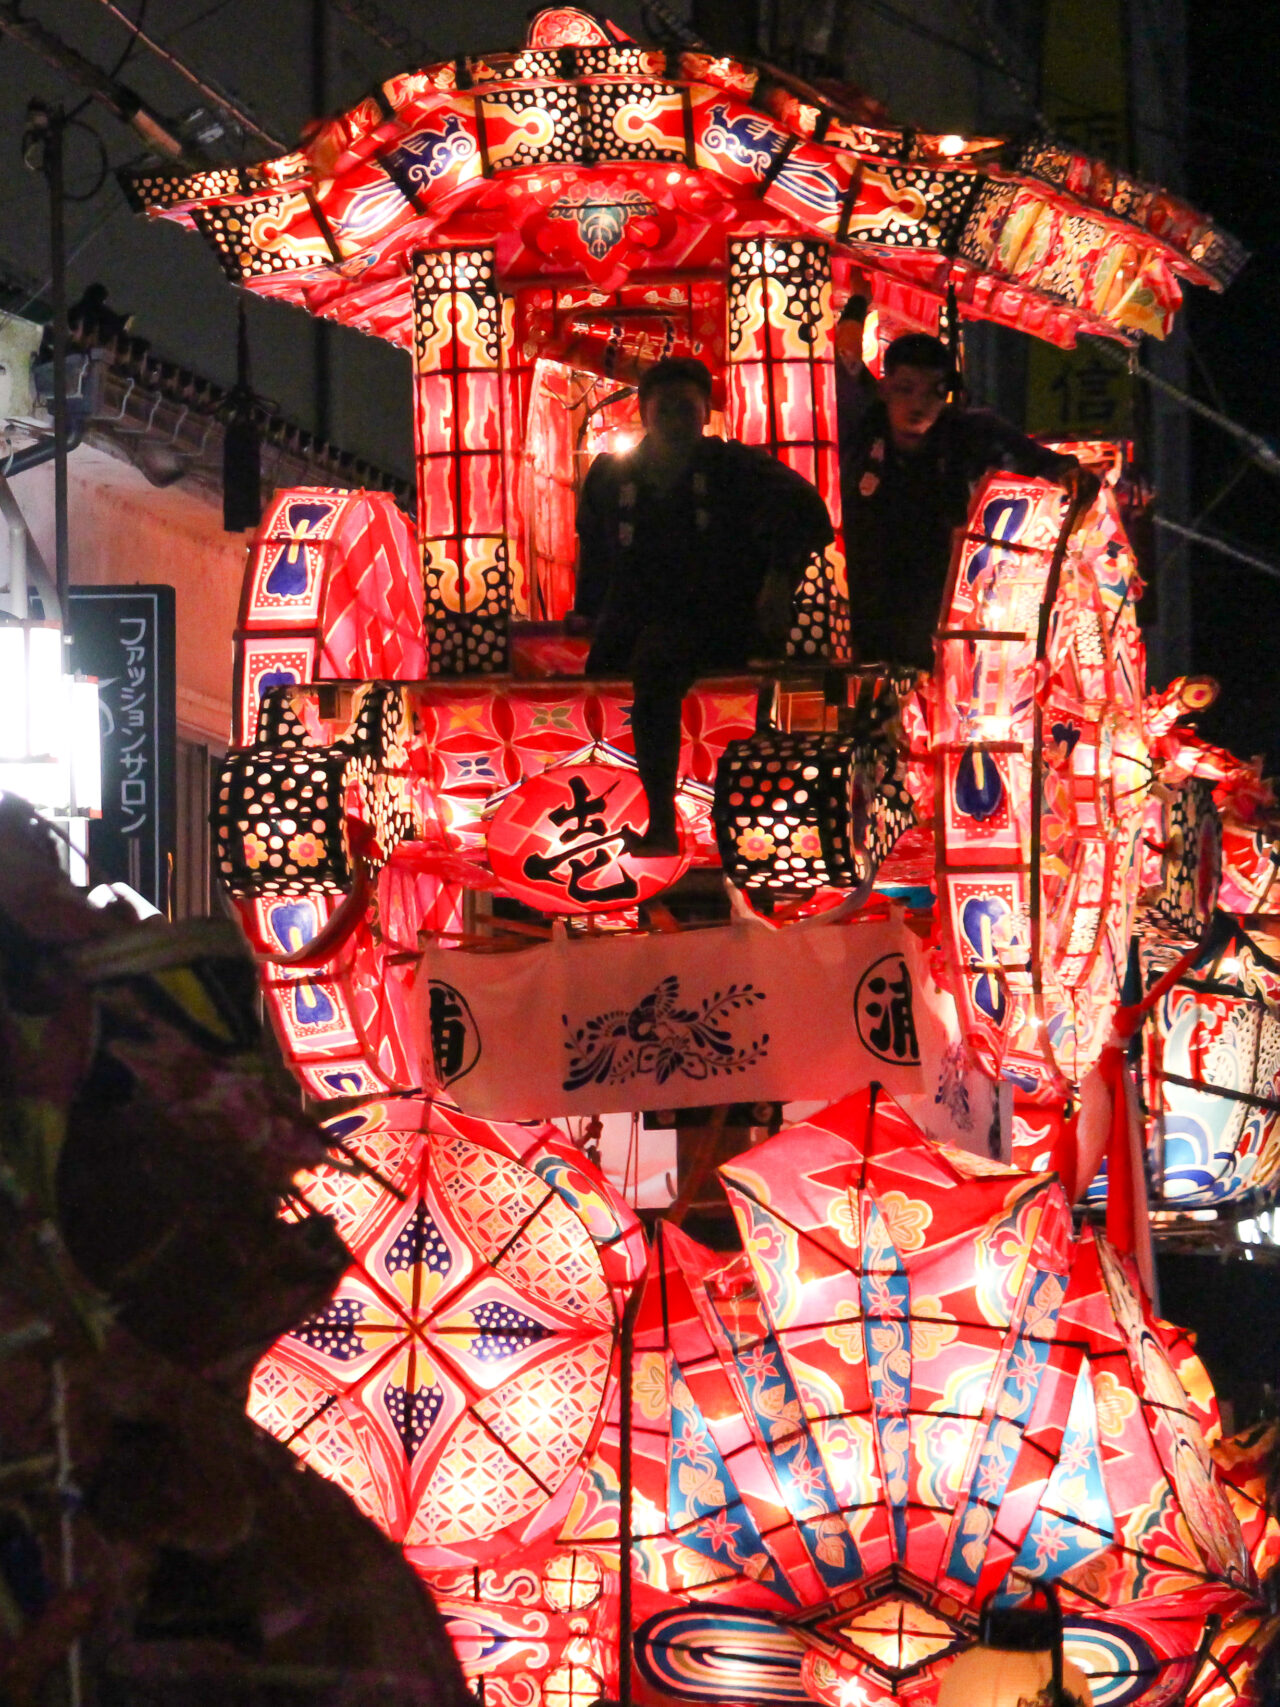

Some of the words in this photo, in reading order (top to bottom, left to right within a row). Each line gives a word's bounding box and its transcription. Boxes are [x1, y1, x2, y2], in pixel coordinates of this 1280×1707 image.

[120, 617, 148, 833] ファッションサロン
